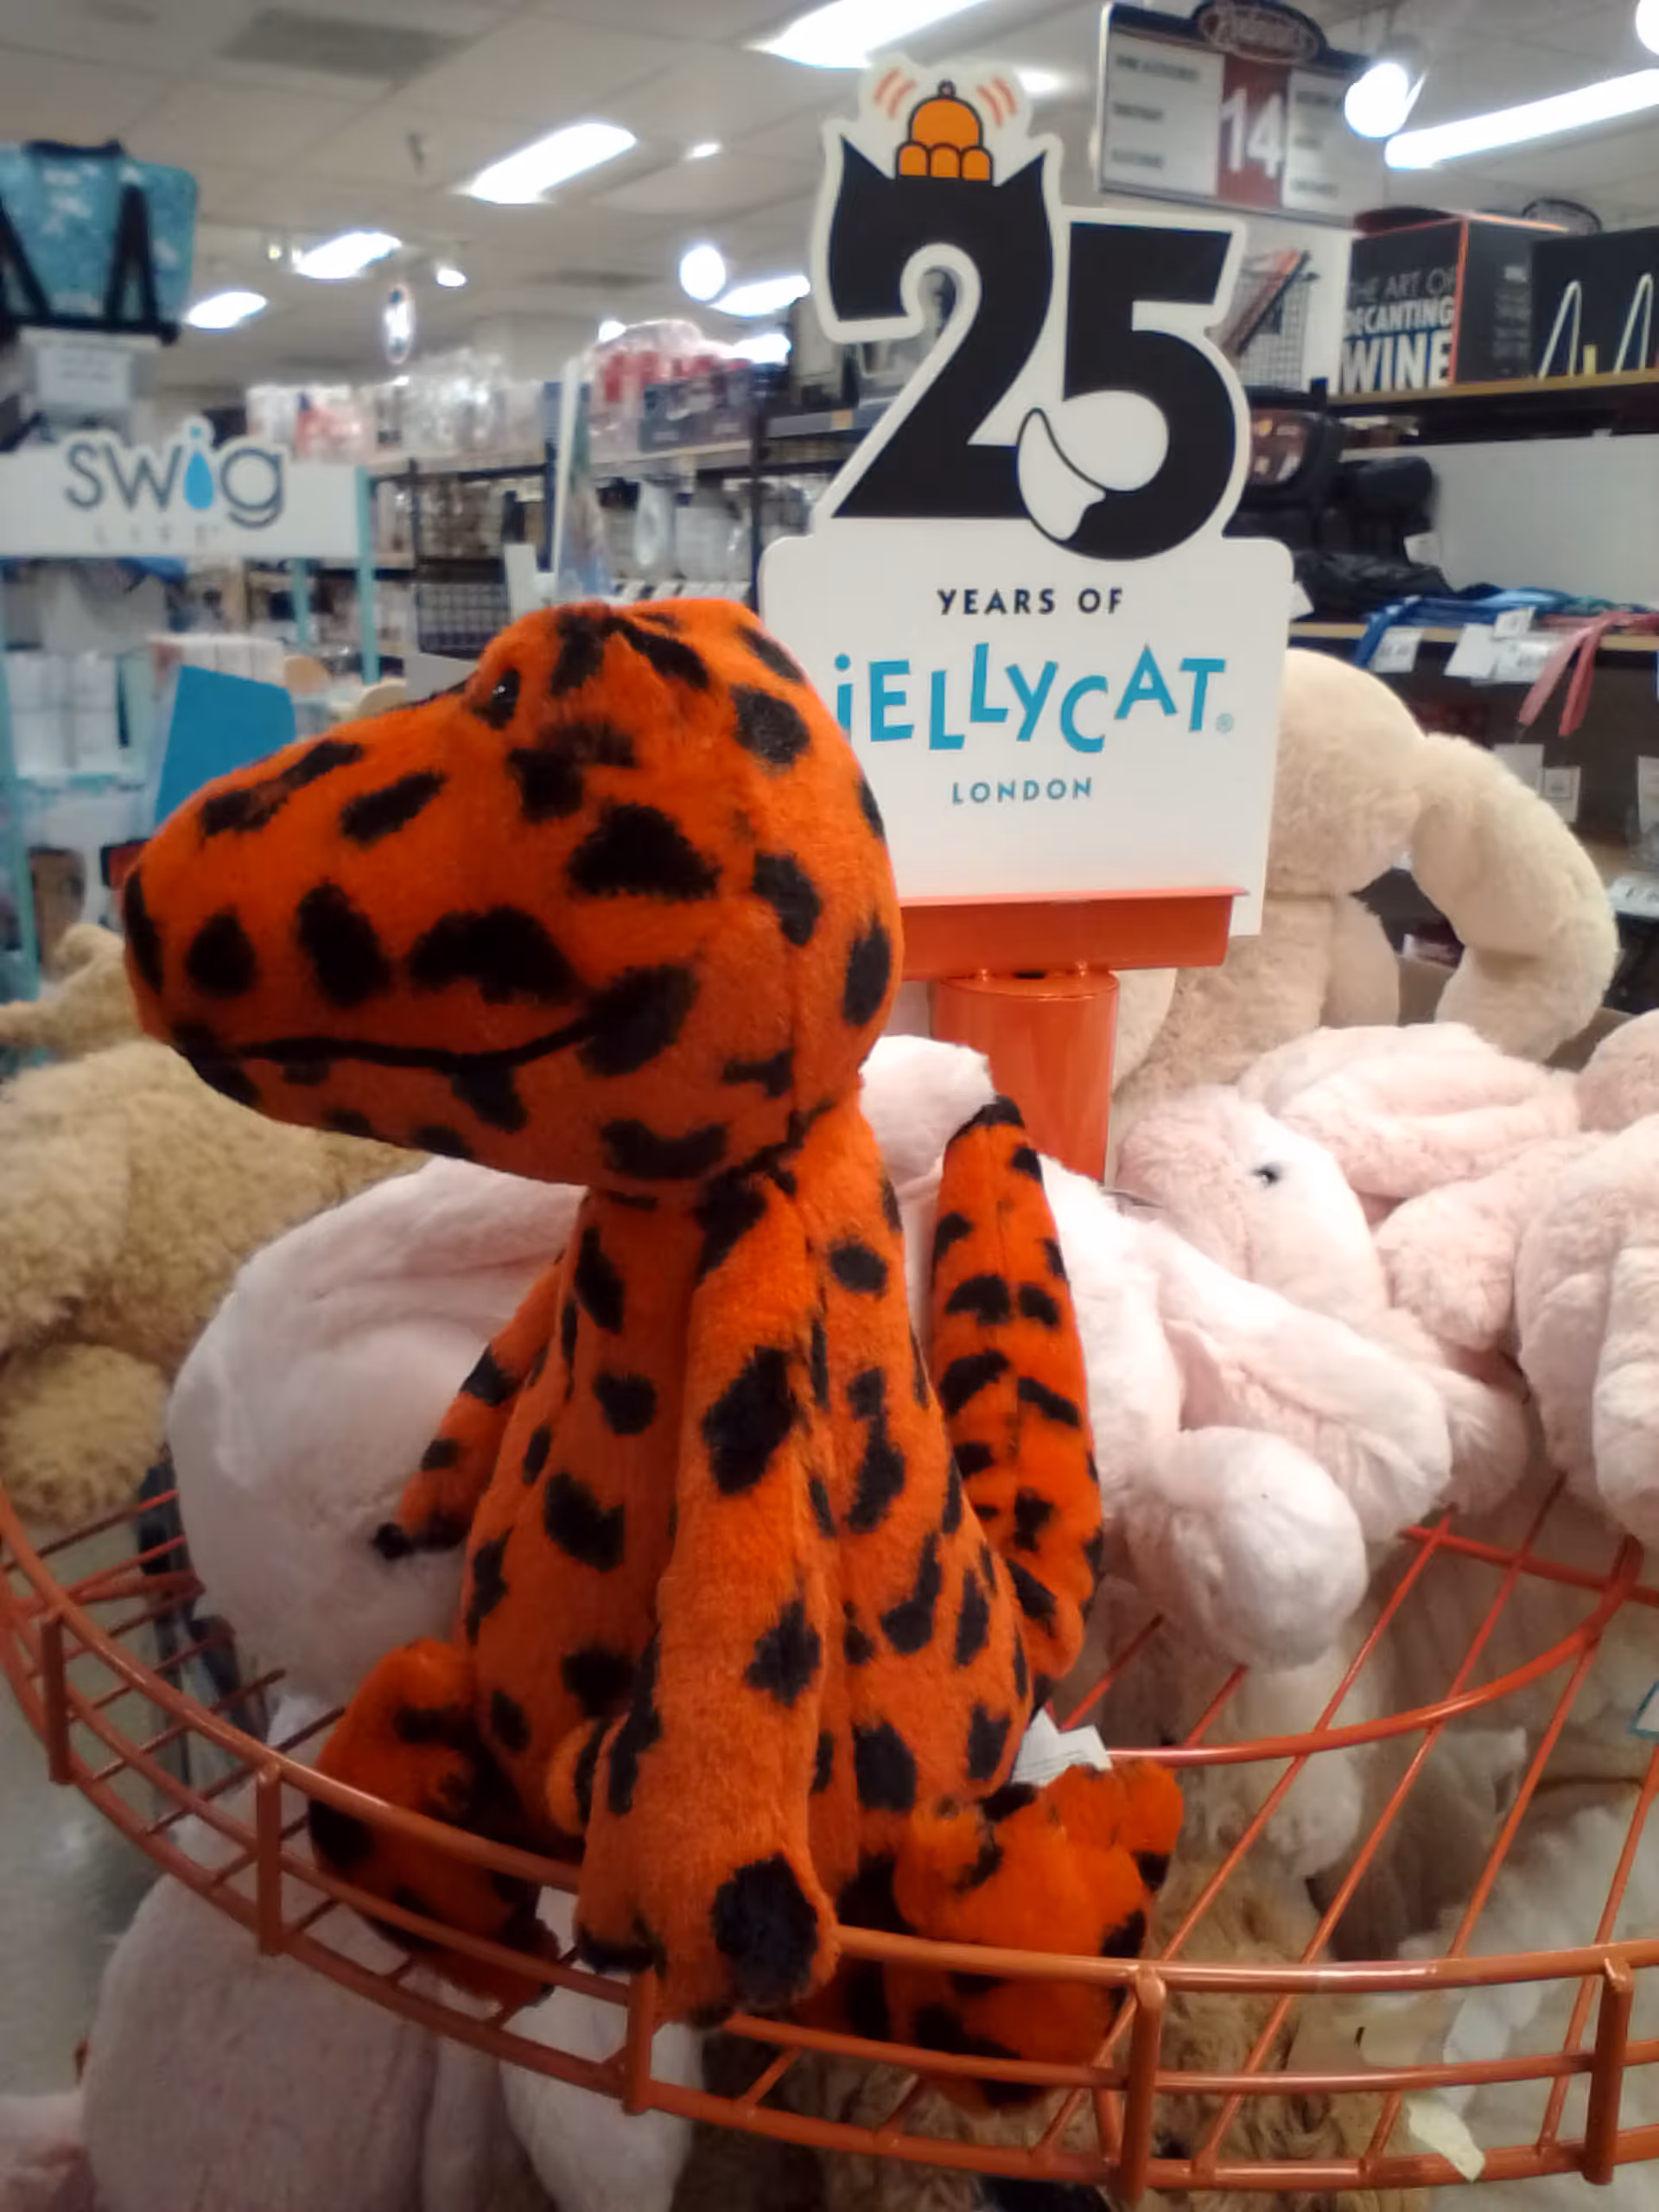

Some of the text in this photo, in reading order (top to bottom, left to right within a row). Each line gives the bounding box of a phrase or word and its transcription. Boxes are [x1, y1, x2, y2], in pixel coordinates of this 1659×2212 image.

[1219, 87, 1284, 179] 14
[830, 134, 1236, 562] 25
[1341, 329, 1455, 395] WINE
[938, 587, 1123, 615] YEARS OF
[952, 778, 1093, 804] LONDON
